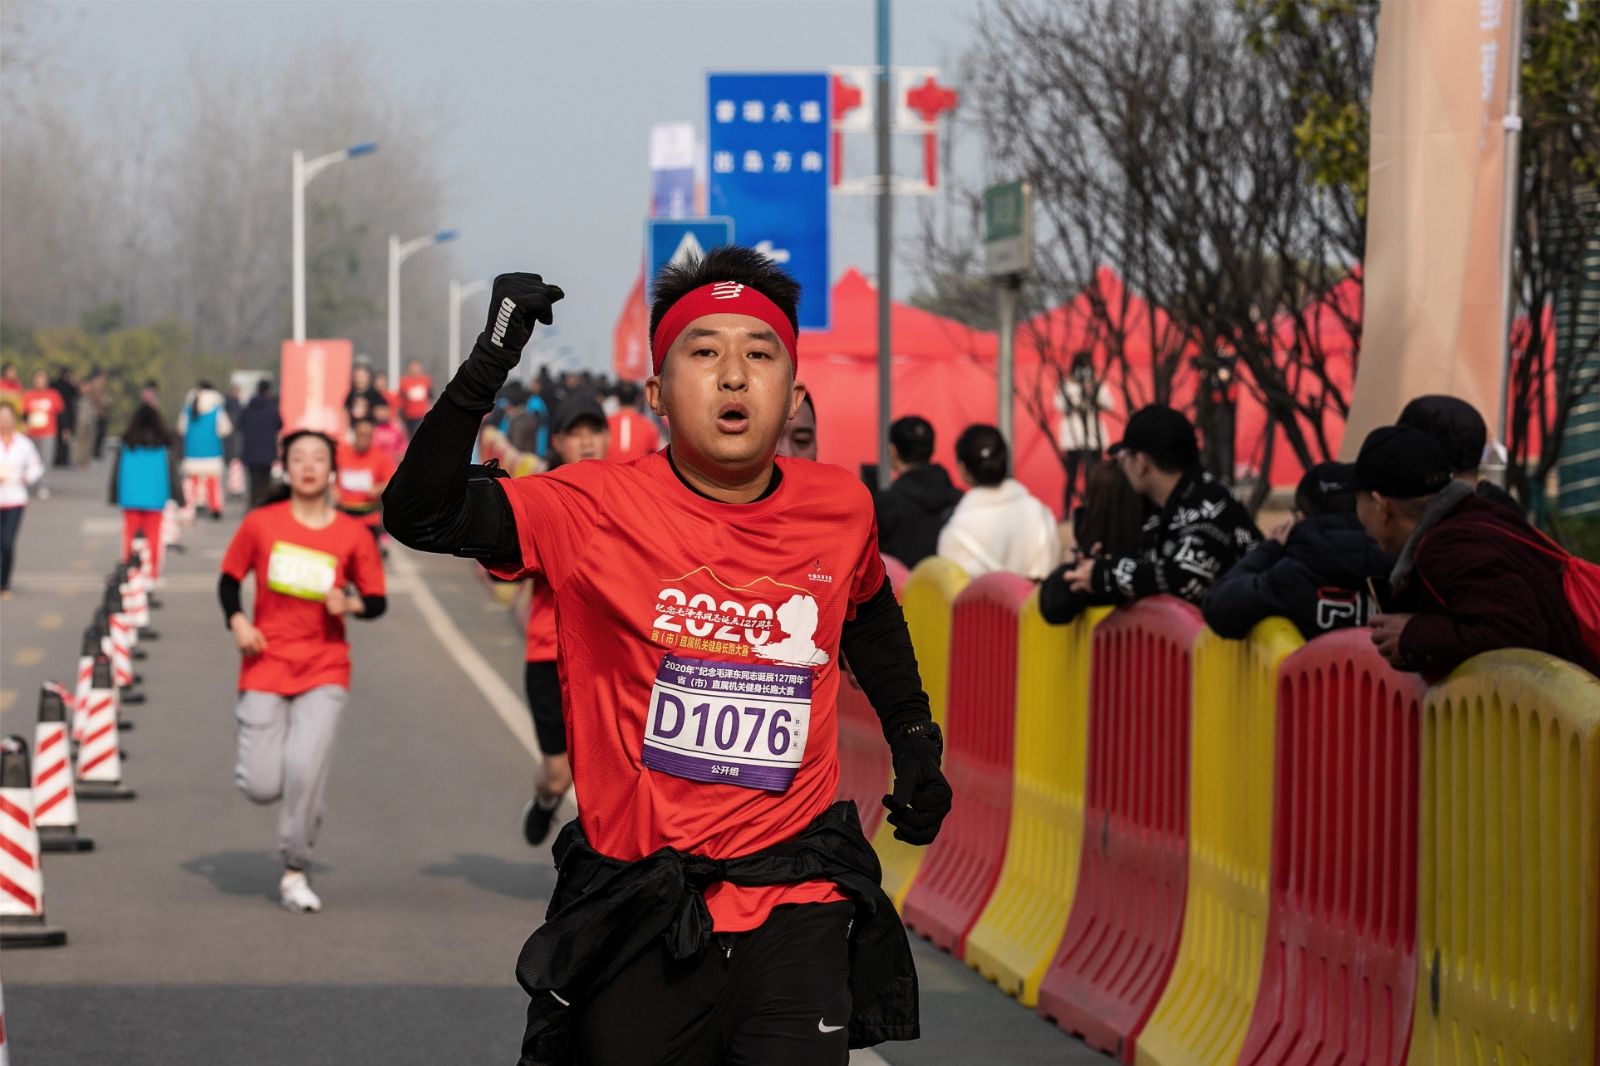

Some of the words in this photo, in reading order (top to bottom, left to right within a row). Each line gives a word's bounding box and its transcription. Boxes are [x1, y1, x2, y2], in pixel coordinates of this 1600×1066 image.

[491, 297, 516, 347] PUMA
[653, 588, 774, 646] 2020
[653, 691, 792, 756] D1076
[711, 765, 739, 777] 公开组
